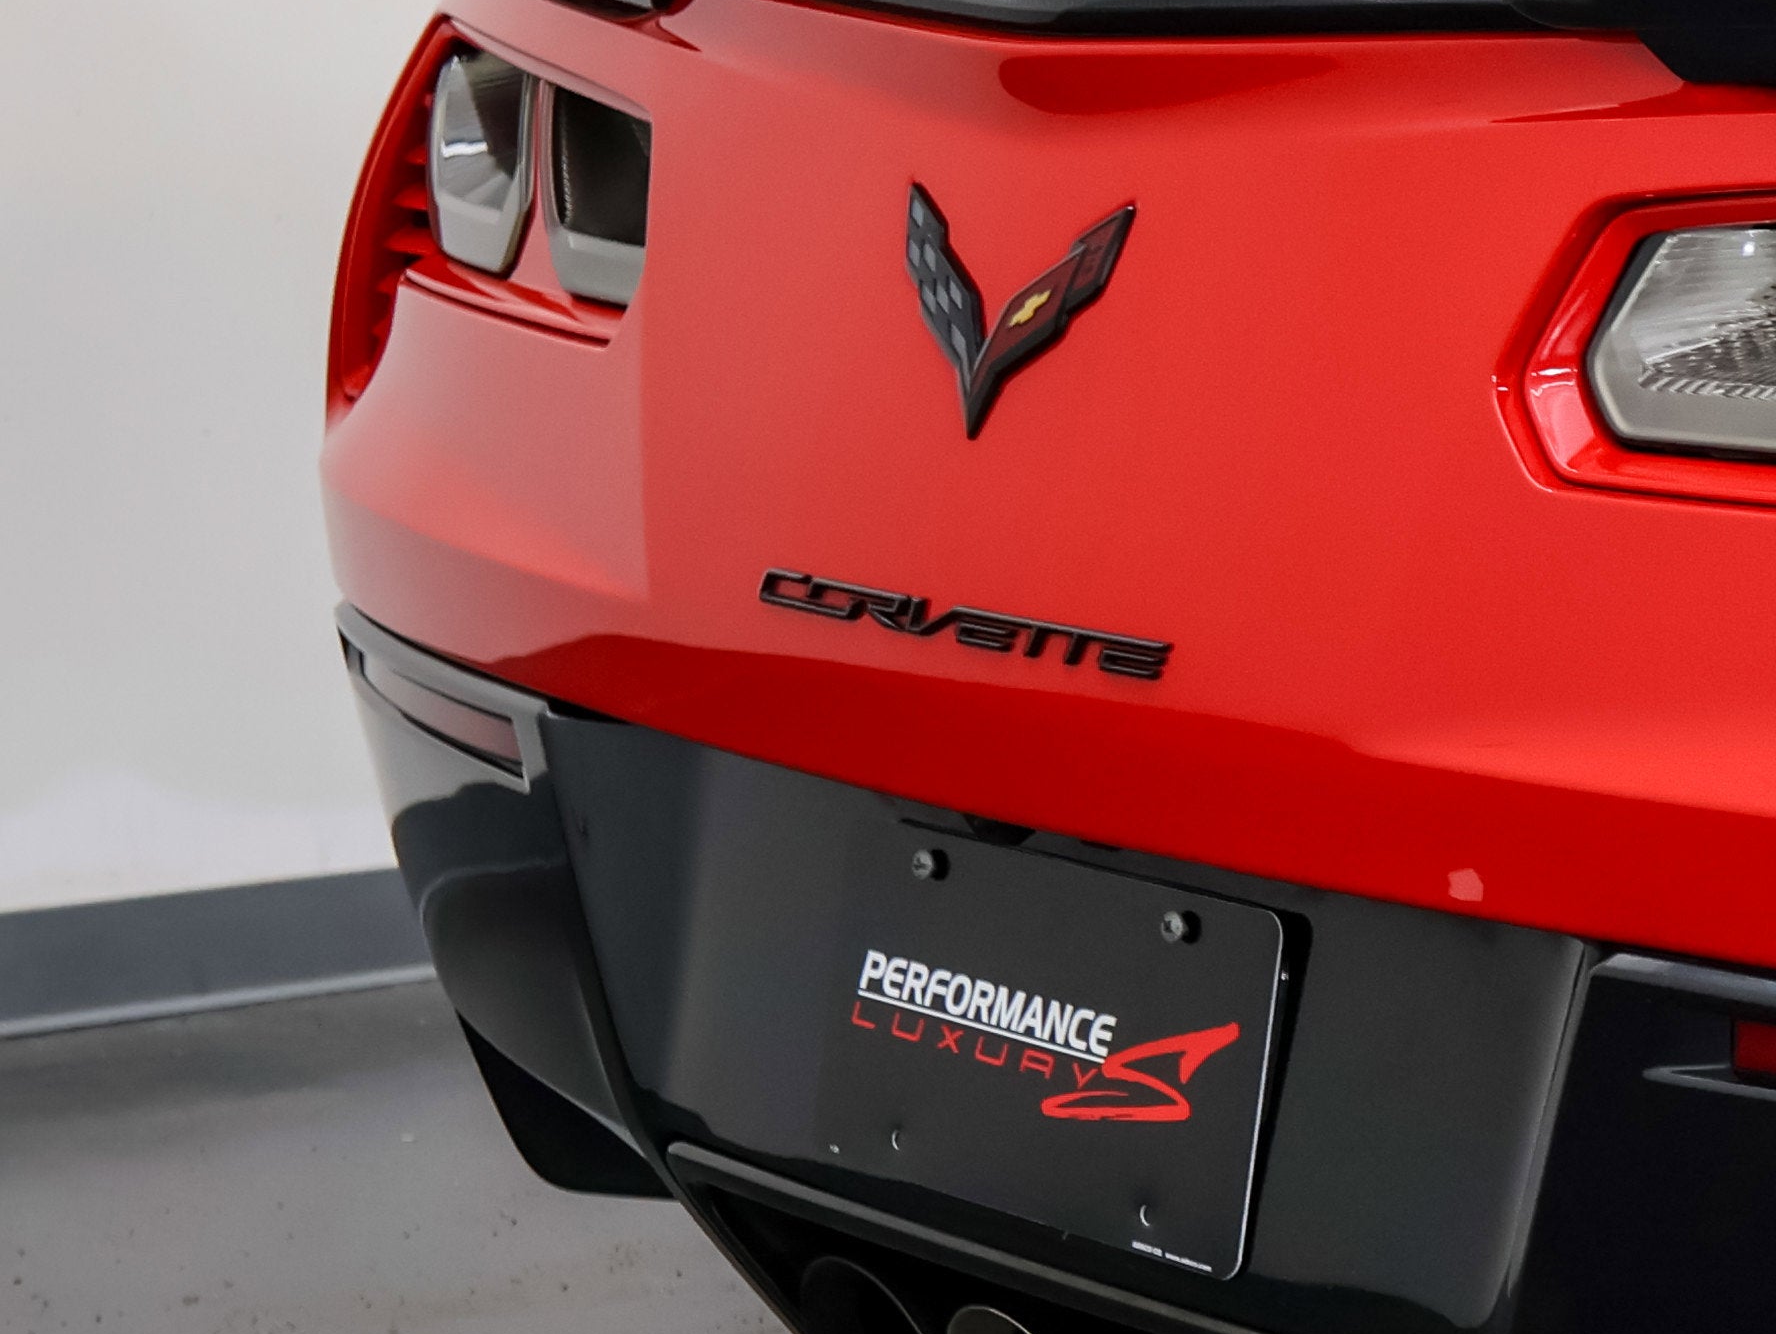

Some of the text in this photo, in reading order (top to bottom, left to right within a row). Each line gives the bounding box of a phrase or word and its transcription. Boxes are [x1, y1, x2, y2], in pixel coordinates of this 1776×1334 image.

[759, 568, 1174, 680] CORVETTE
[851, 1001, 1100, 1090] LUXURY
[858, 948, 1118, 1058] PERFORMANCE
